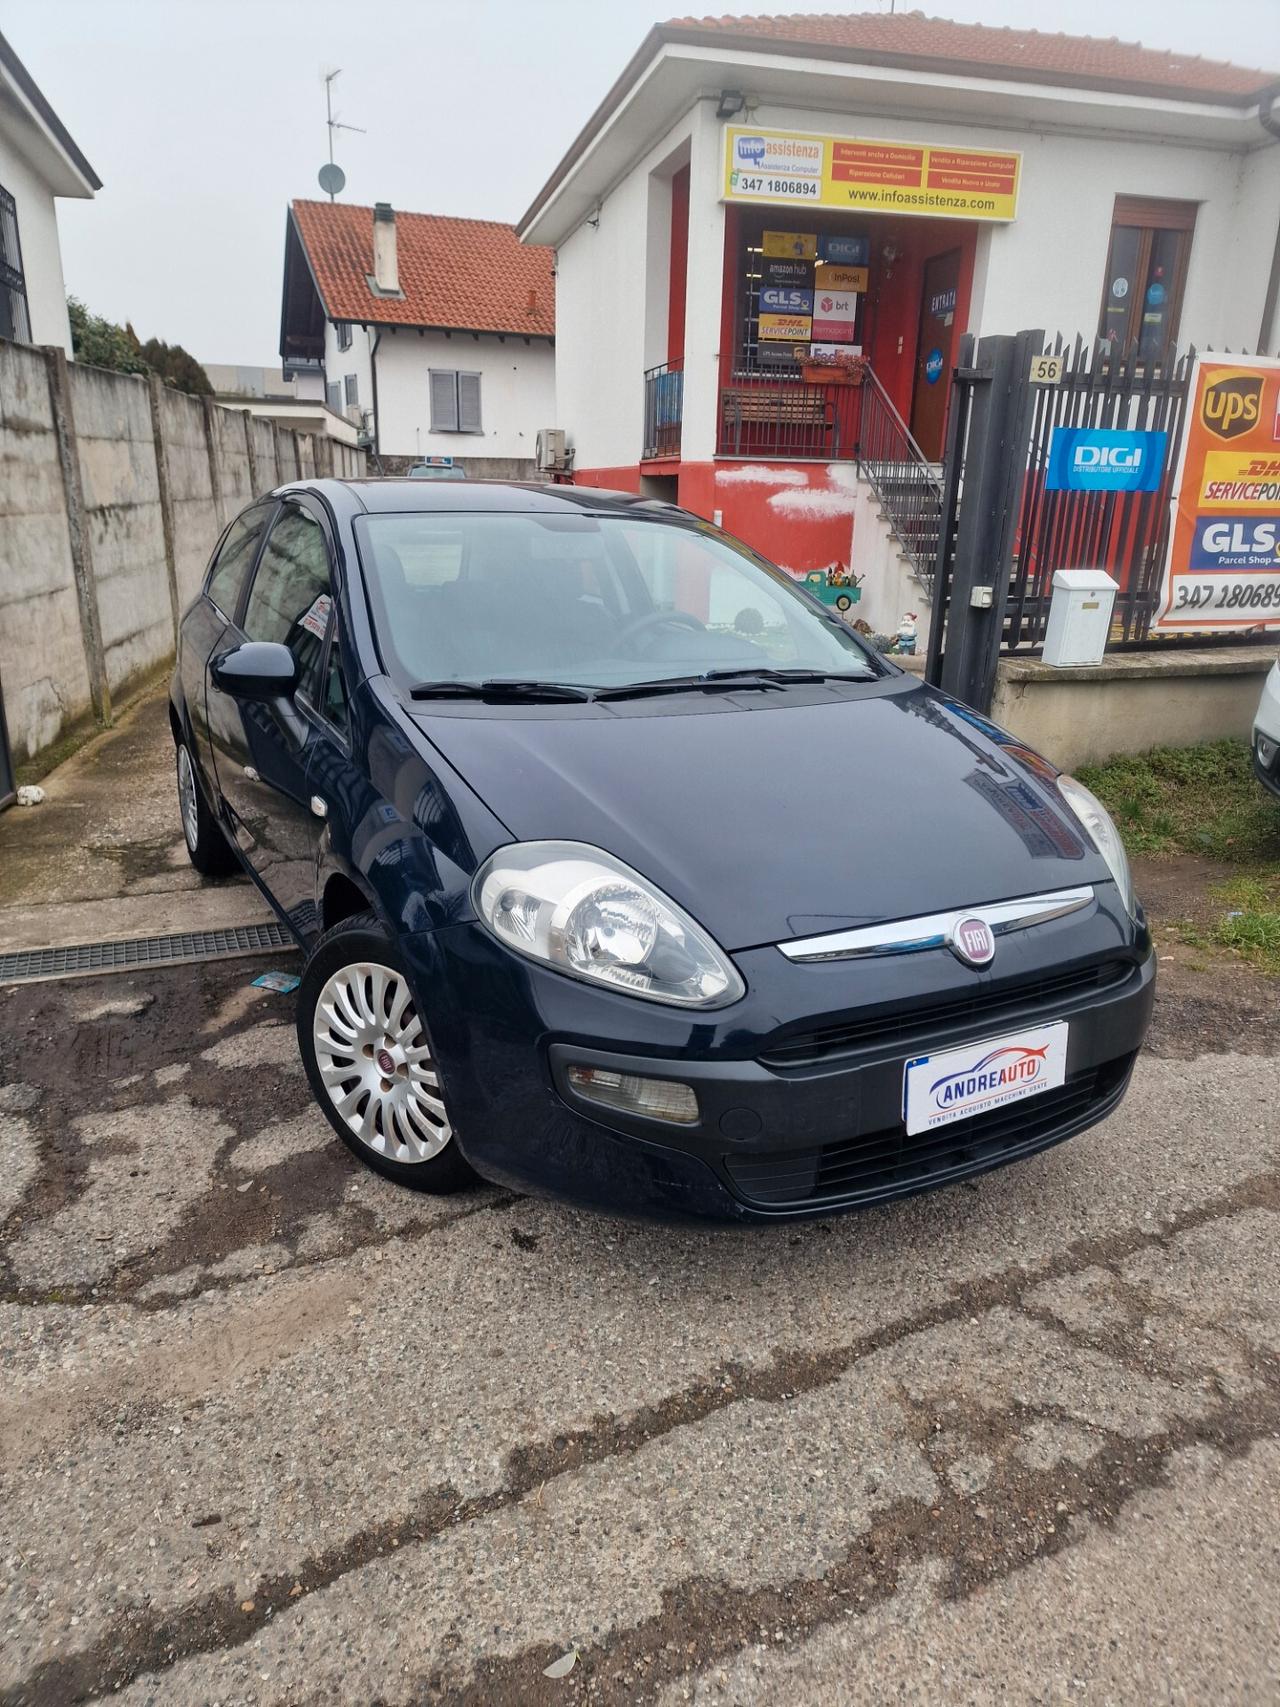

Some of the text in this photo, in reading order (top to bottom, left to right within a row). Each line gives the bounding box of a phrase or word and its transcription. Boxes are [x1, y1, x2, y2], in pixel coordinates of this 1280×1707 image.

[766, 140, 820, 160] assistenza
[761, 162, 819, 174] Assistenza Computer
[742, 178, 817, 195] 347 1806894
[848, 188, 995, 210] www.infoassistenza.com
[828, 242, 860, 254] DIGI
[769, 264, 807, 275] amazon hub
[834, 273, 860, 283] InPost
[763, 290, 802, 306] GLS
[836, 301, 849, 311] brt
[932, 290, 955, 311] ENTRATA
[762, 326, 808, 336] SERVICEPOINT
[776, 318, 804, 327] DHL
[1038, 361, 1057, 378] 56
[1205, 391, 1258, 430] ups
[1074, 446, 1142, 467] DIGI
[1112, 466, 1139, 474] UFFICIALE
[1204, 481, 1280, 500] SERVICEPOI
[1202, 523, 1276, 553] GLS
[1218, 556, 1272, 566] Parcel Shop
[1175, 585, 1214, 610] 347
[963, 929, 989, 953] FIAT
[943, 1059, 1037, 1103] ANDREAUTO
[928, 1082, 1048, 1126] VENDITA ACQUISTO MACCHINE USATE
